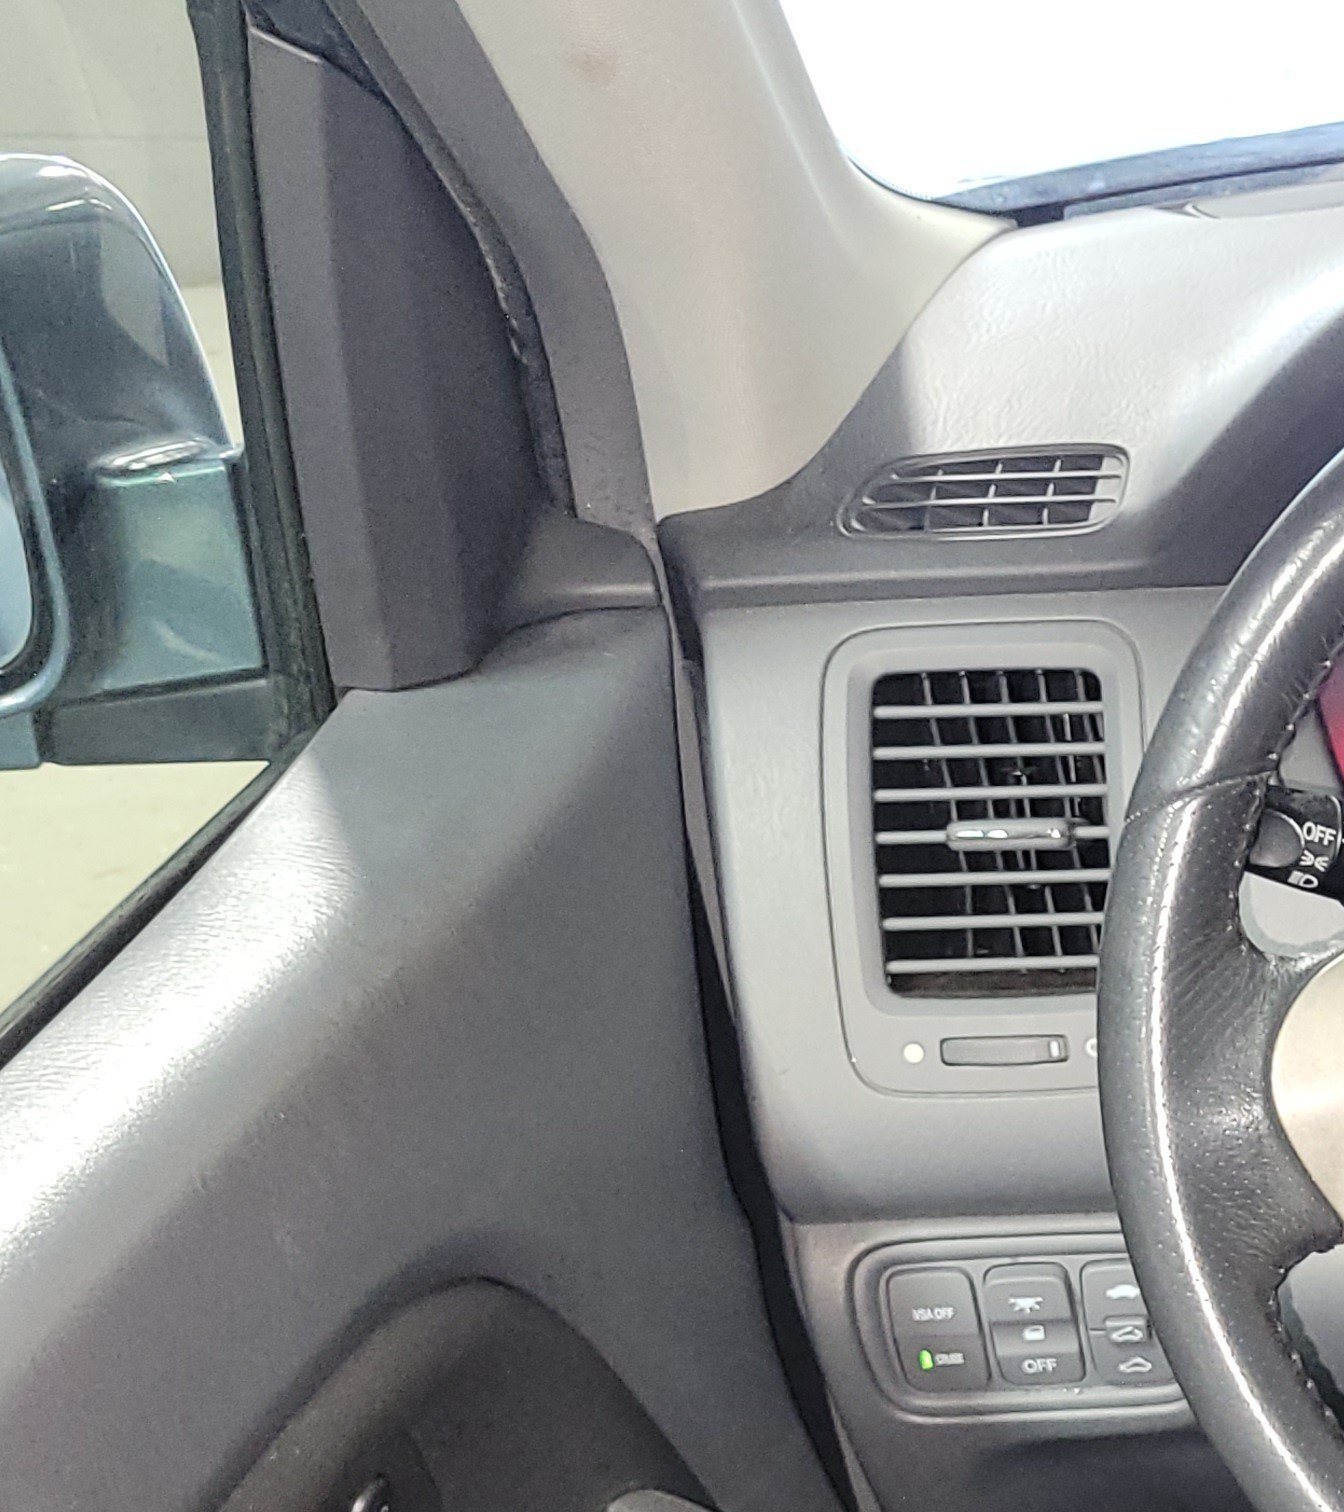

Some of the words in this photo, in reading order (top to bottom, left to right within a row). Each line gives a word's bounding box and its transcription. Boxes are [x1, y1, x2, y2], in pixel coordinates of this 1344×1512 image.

[1302, 822, 1337, 846] OFF
[934, 1307, 955, 1320] OFF
[1021, 1358, 1057, 1373] OFF
